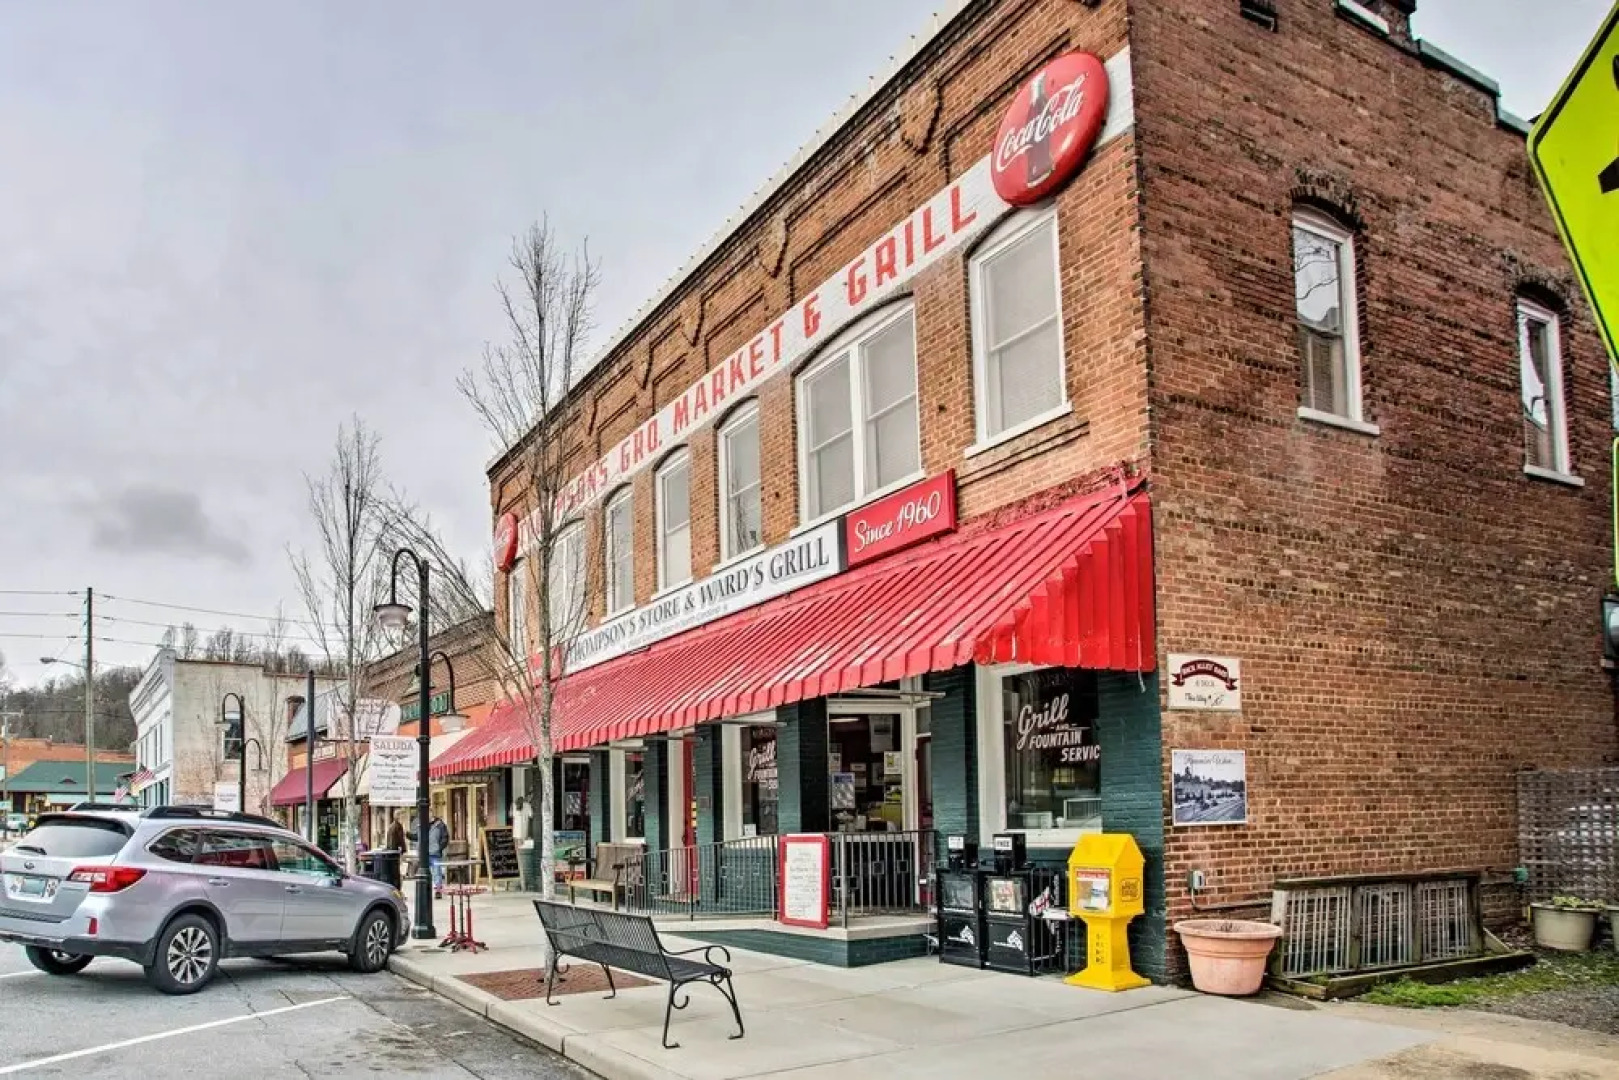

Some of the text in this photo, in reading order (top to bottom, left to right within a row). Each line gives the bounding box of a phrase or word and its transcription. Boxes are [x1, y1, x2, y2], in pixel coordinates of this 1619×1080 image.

[673, 318, 784, 434] MARKET
[847, 186, 977, 306] GRILL
[855, 491, 941, 552] Since 1960
[638, 596, 681, 631] STORE
[684, 590, 694, 611] &
[700, 560, 764, 612] WARD'S
[770, 536, 830, 581] GRILL
[373, 741, 414, 751] SALUDA
[1017, 693, 1069, 750] Grill
[1029, 731, 1082, 749] FOUNTAIN
